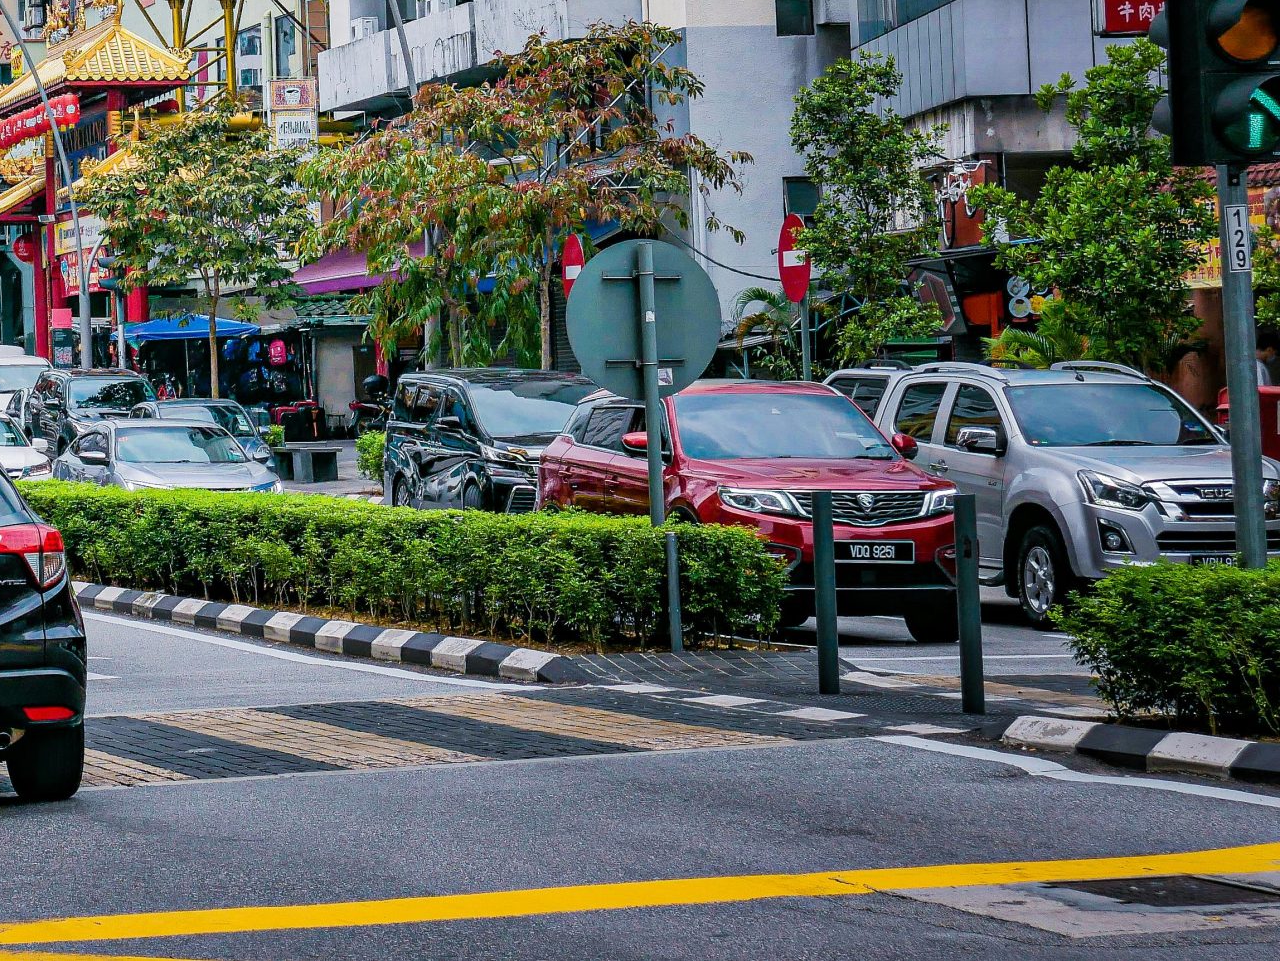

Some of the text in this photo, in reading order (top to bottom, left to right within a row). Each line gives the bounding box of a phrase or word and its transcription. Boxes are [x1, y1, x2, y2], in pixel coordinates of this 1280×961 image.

[1232, 208, 1247, 268] 129
[1200, 488, 1235, 498] ISUZ
[849, 544, 895, 559] VDQ 9251
